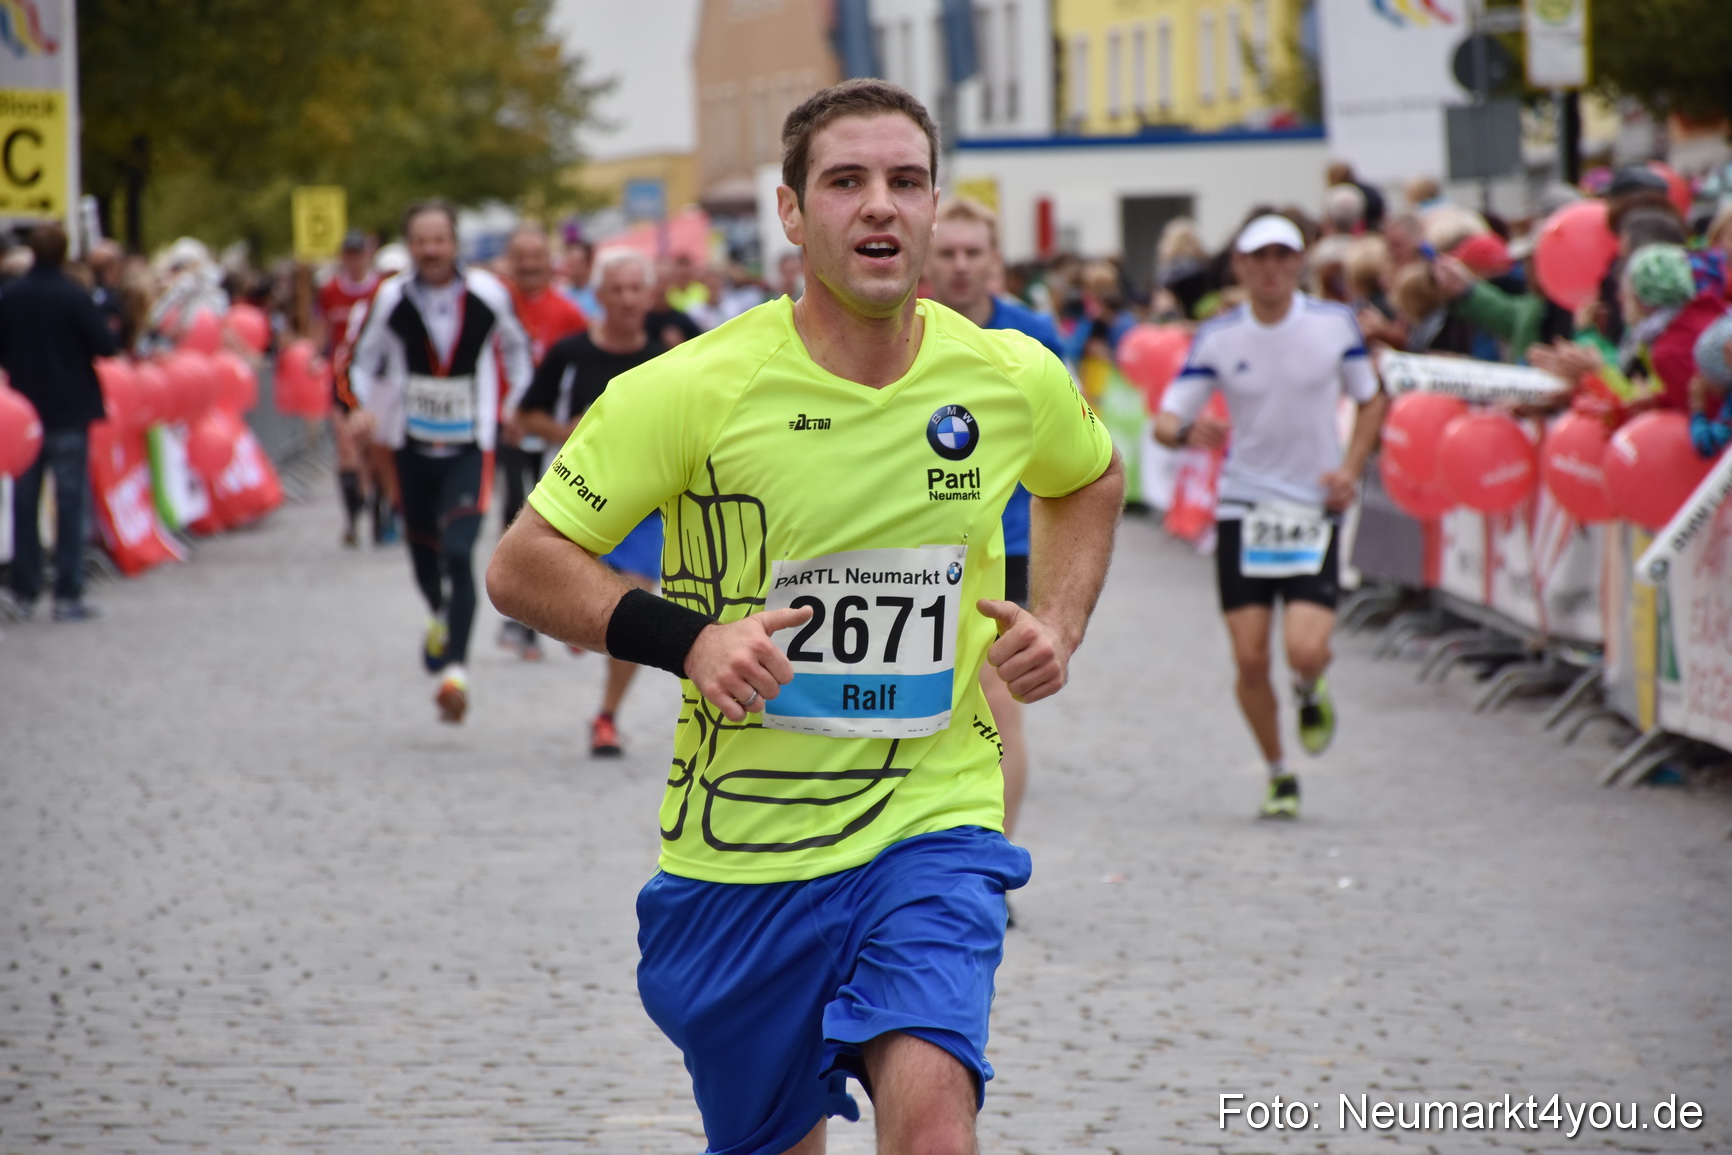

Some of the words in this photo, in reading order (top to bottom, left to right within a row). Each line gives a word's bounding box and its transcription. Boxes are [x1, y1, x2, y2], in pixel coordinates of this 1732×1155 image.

[4, 127, 43, 189] C
[931, 406, 973, 424] BMW
[927, 467, 981, 490] Partl
[569, 474, 608, 512] Partl
[929, 489, 981, 501] Neumarkt
[775, 568, 839, 589] PARTL
[845, 567, 940, 585] Neumarkt
[786, 594, 945, 664] 2671
[842, 684, 896, 711] Ralf
